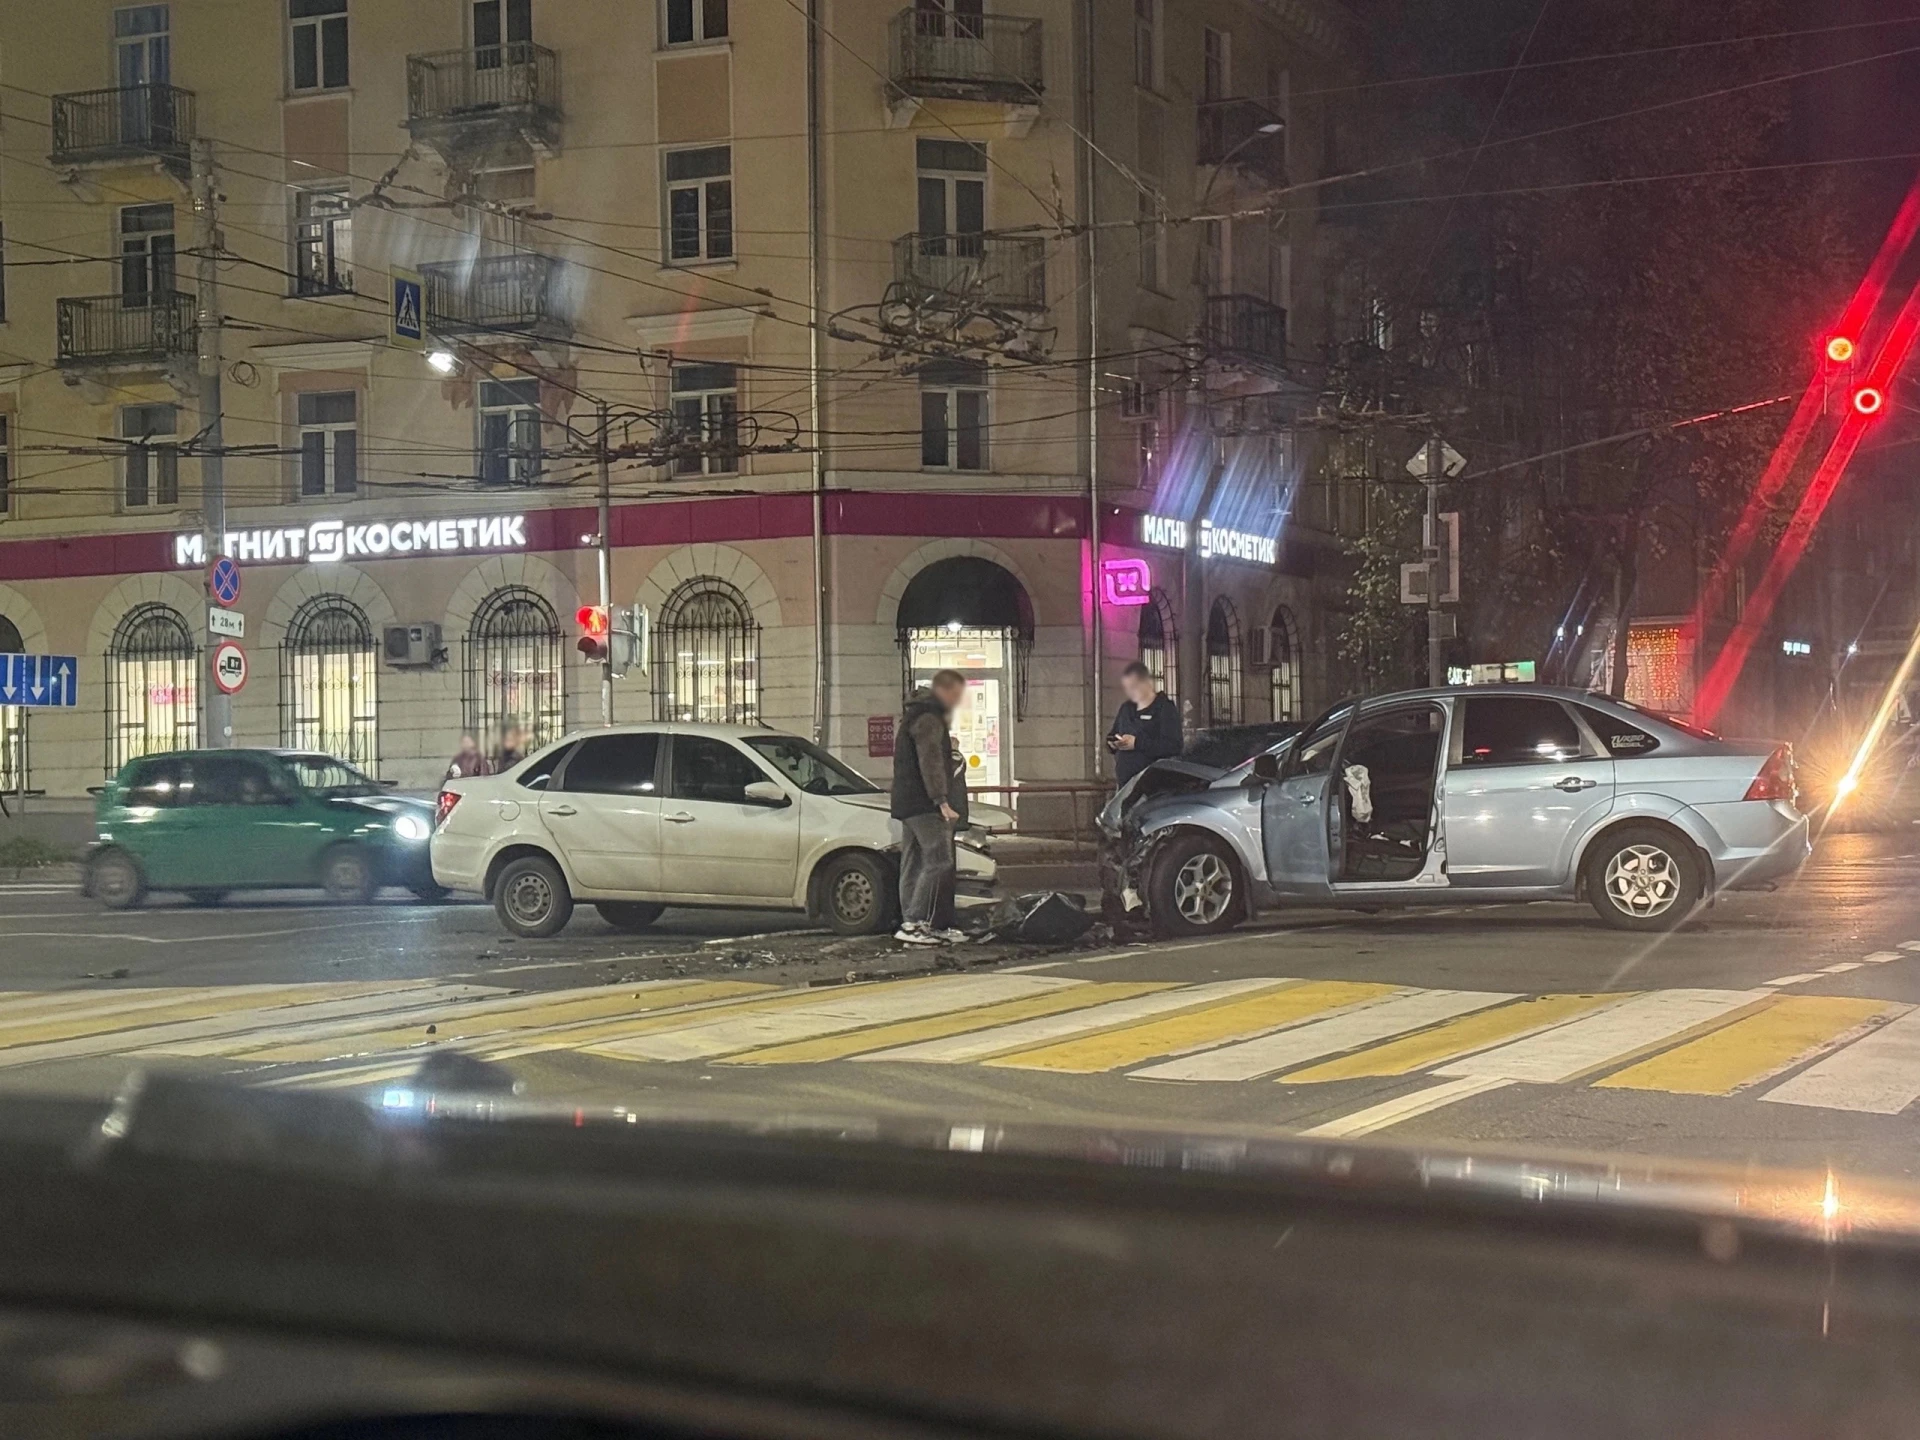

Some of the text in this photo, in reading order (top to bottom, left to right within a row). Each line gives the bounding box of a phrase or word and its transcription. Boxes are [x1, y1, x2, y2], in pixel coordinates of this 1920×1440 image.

[176, 515, 527, 564] МГНИТ КОСМЕТИК
[1212, 527, 1276, 564] КОСМЕТИК
